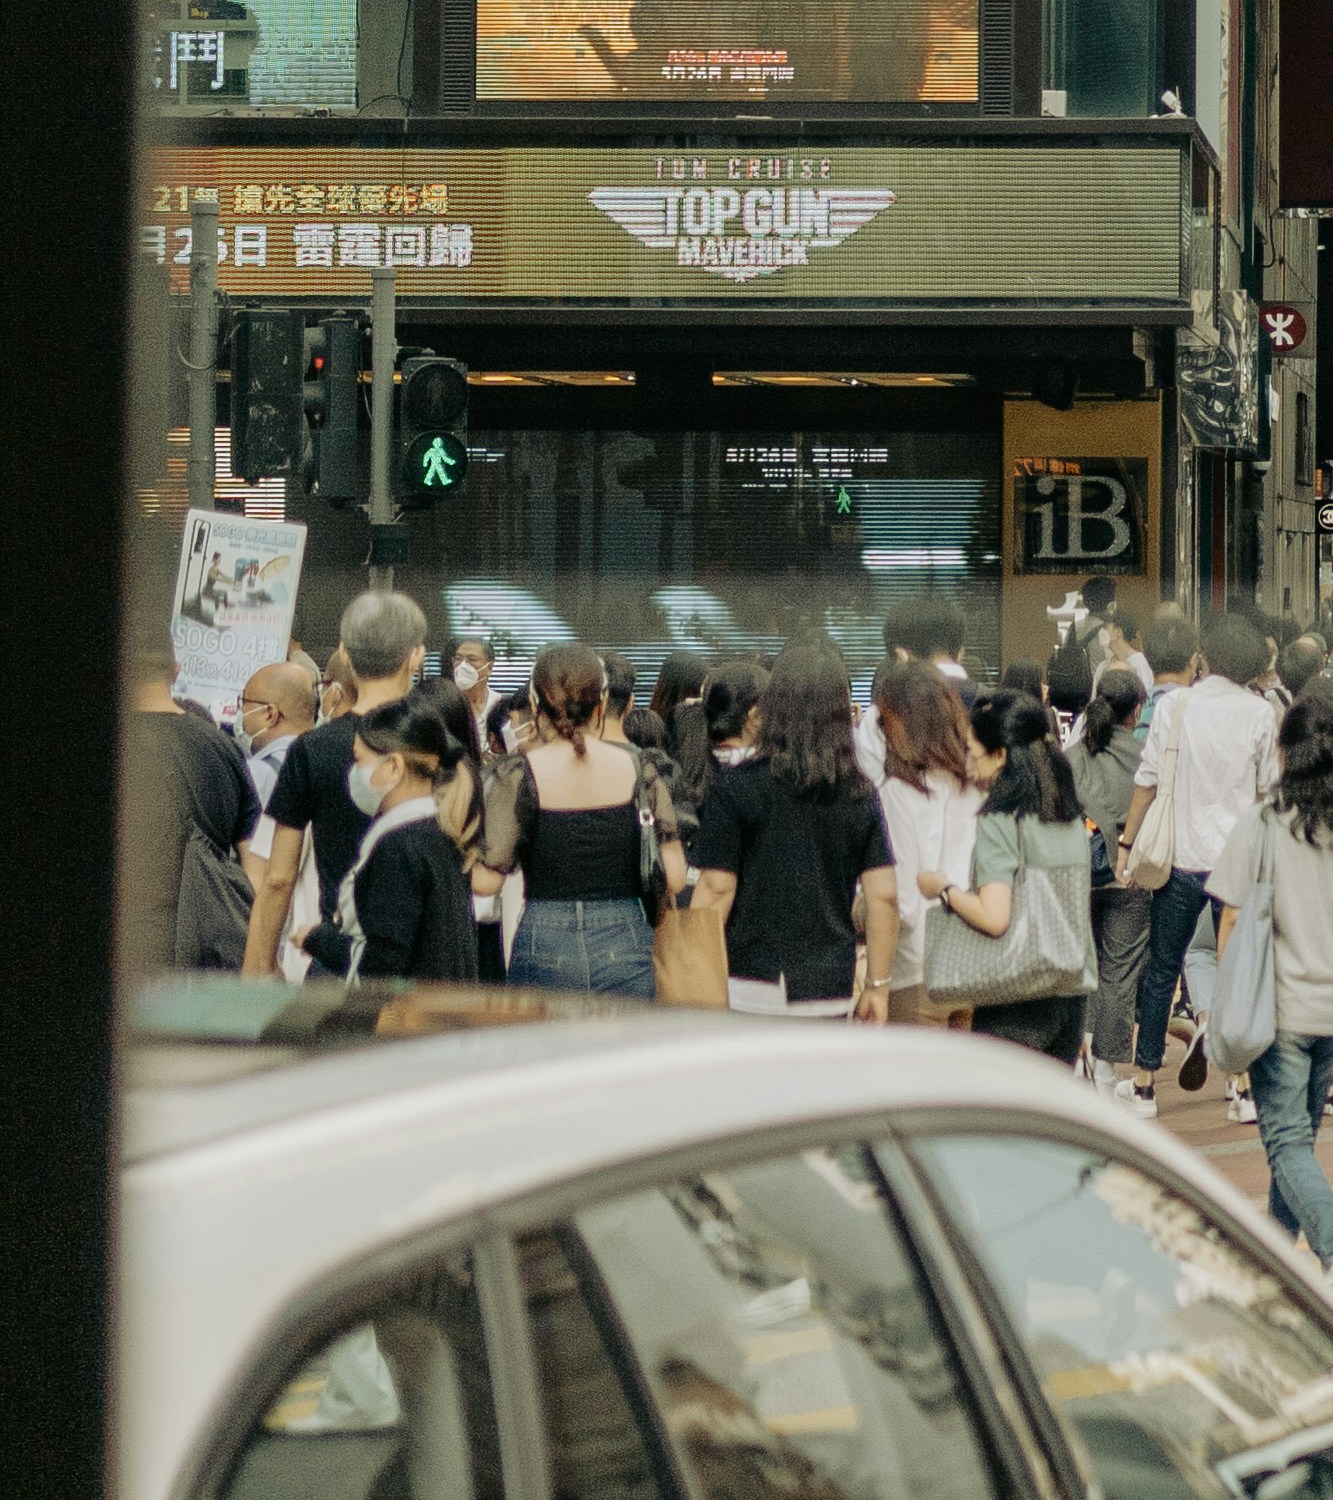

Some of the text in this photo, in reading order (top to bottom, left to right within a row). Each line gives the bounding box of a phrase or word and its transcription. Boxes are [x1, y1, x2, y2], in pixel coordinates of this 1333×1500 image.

[656, 157, 832, 180] TOM CRUISE
[665, 187, 830, 238] TOP GUN
[212, 522, 246, 540] SOGO
[1033, 475, 1130, 559] iB
[174, 624, 238, 653] SOGO
